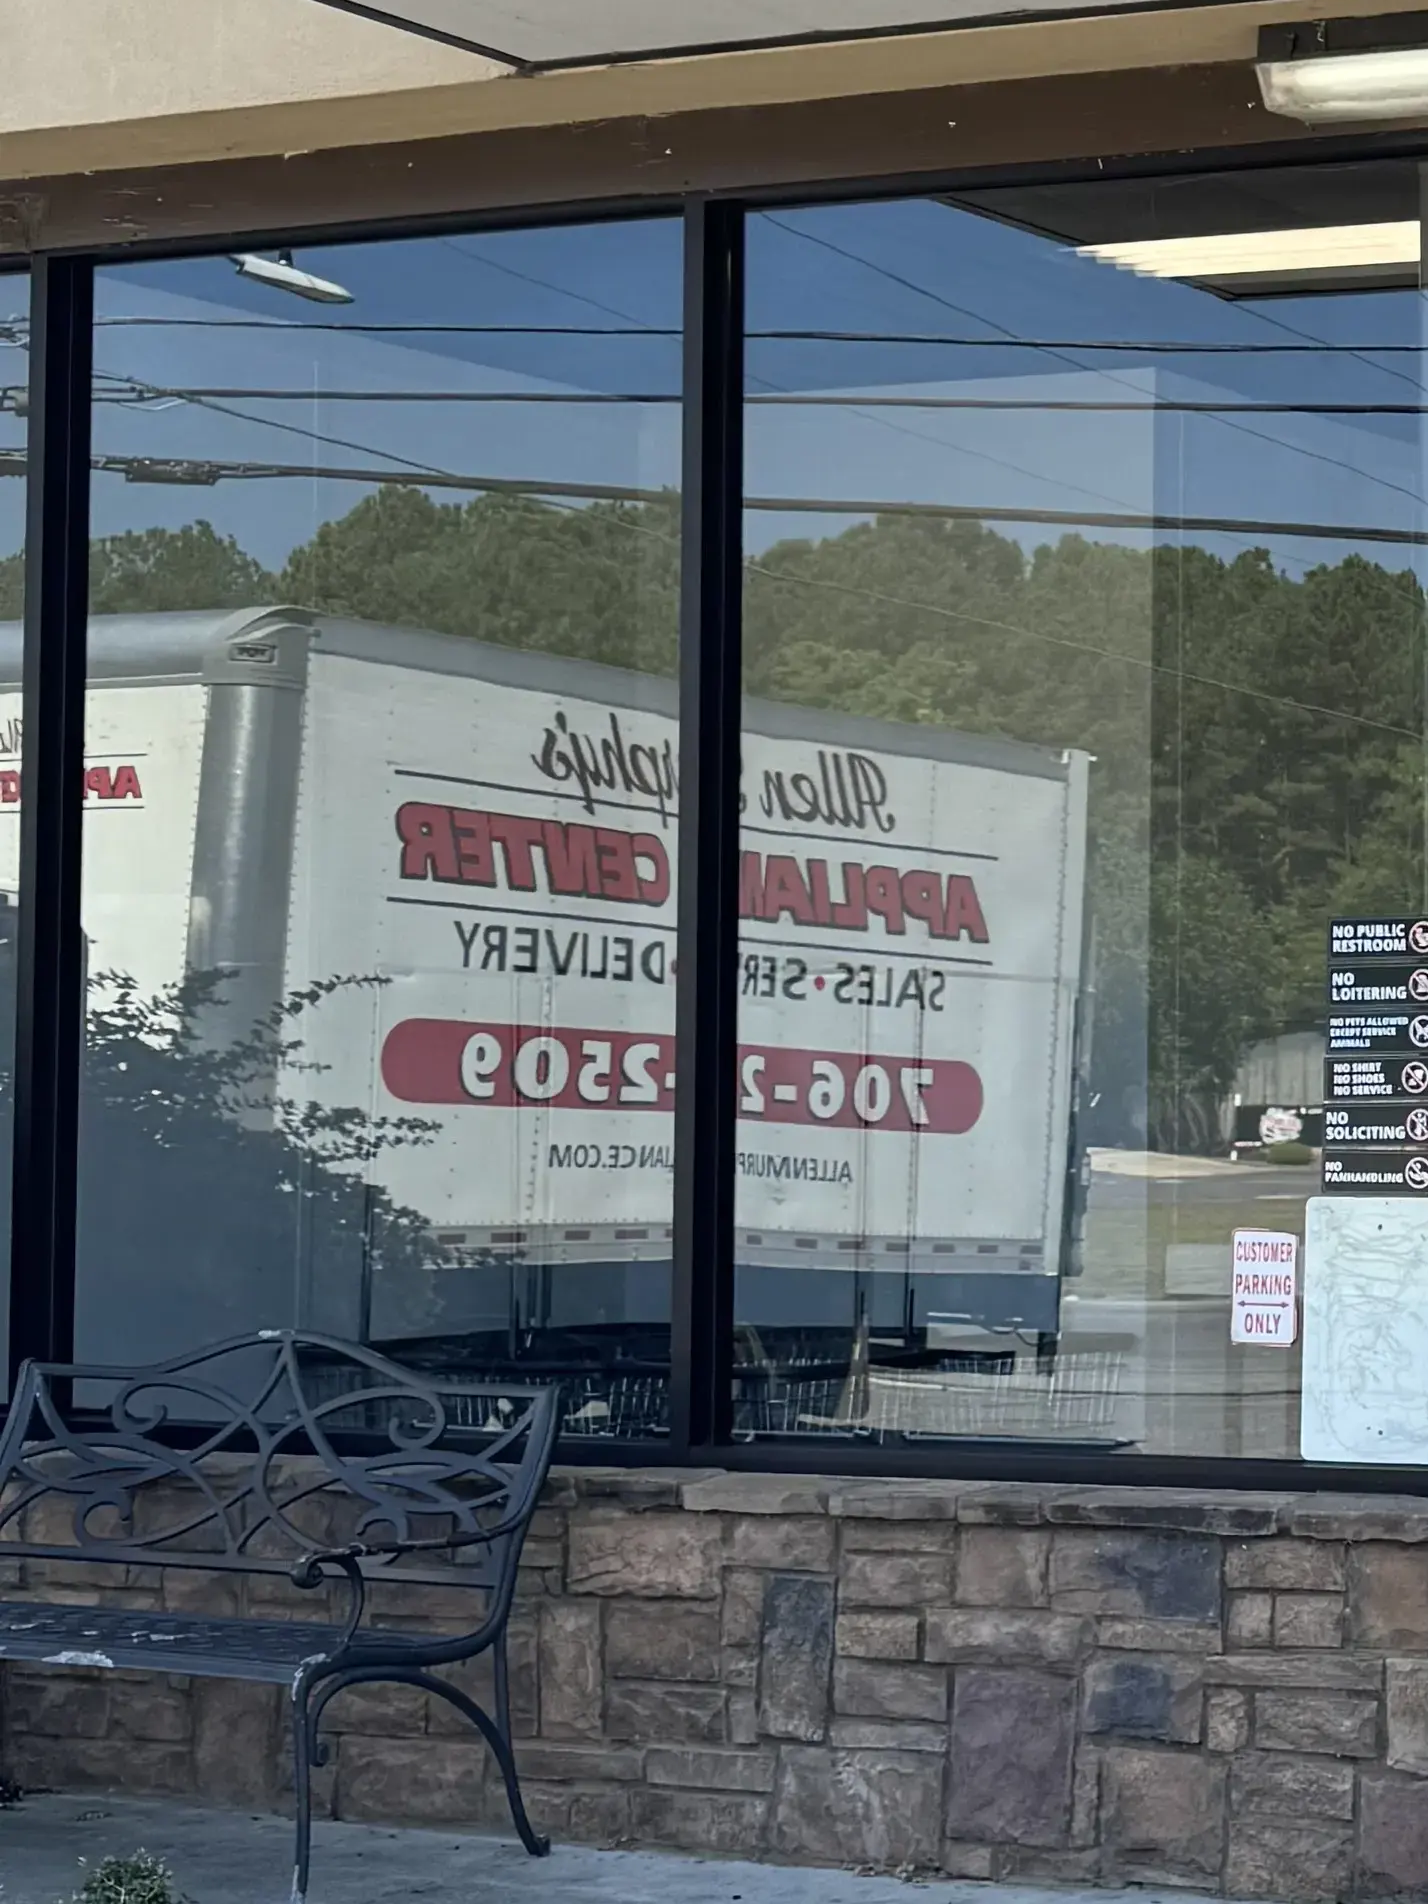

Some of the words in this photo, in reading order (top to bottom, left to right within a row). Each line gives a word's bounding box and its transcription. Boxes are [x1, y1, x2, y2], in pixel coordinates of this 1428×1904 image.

[1332, 925, 1355, 938] NO
[1357, 924, 1406, 938] PUBLIC
[1332, 938, 1407, 952] RESTROOM
[1332, 972, 1355, 986] NO
[1332, 986, 1408, 1001] LOITERING
[1330, 1018, 1344, 1026] NO
[1334, 1063, 1351, 1073] NO
[1352, 1062, 1382, 1072] SHIRT
[1334, 1074, 1351, 1084] NO
[1352, 1073, 1385, 1083] SHOES
[1334, 1085, 1351, 1095] NO
[1352, 1084, 1393, 1095] SERVICE
[1326, 1111, 1349, 1125] NO
[1325, 1126, 1406, 1140] SOLICITING
[1325, 1162, 1342, 1171] NO
[1325, 1172, 1403, 1183] PANHANDLING
[1236, 1241, 1293, 1263] CUSTOMER
[1235, 1274, 1292, 1296] PARKING
[1244, 1312, 1281, 1335] ONLY
